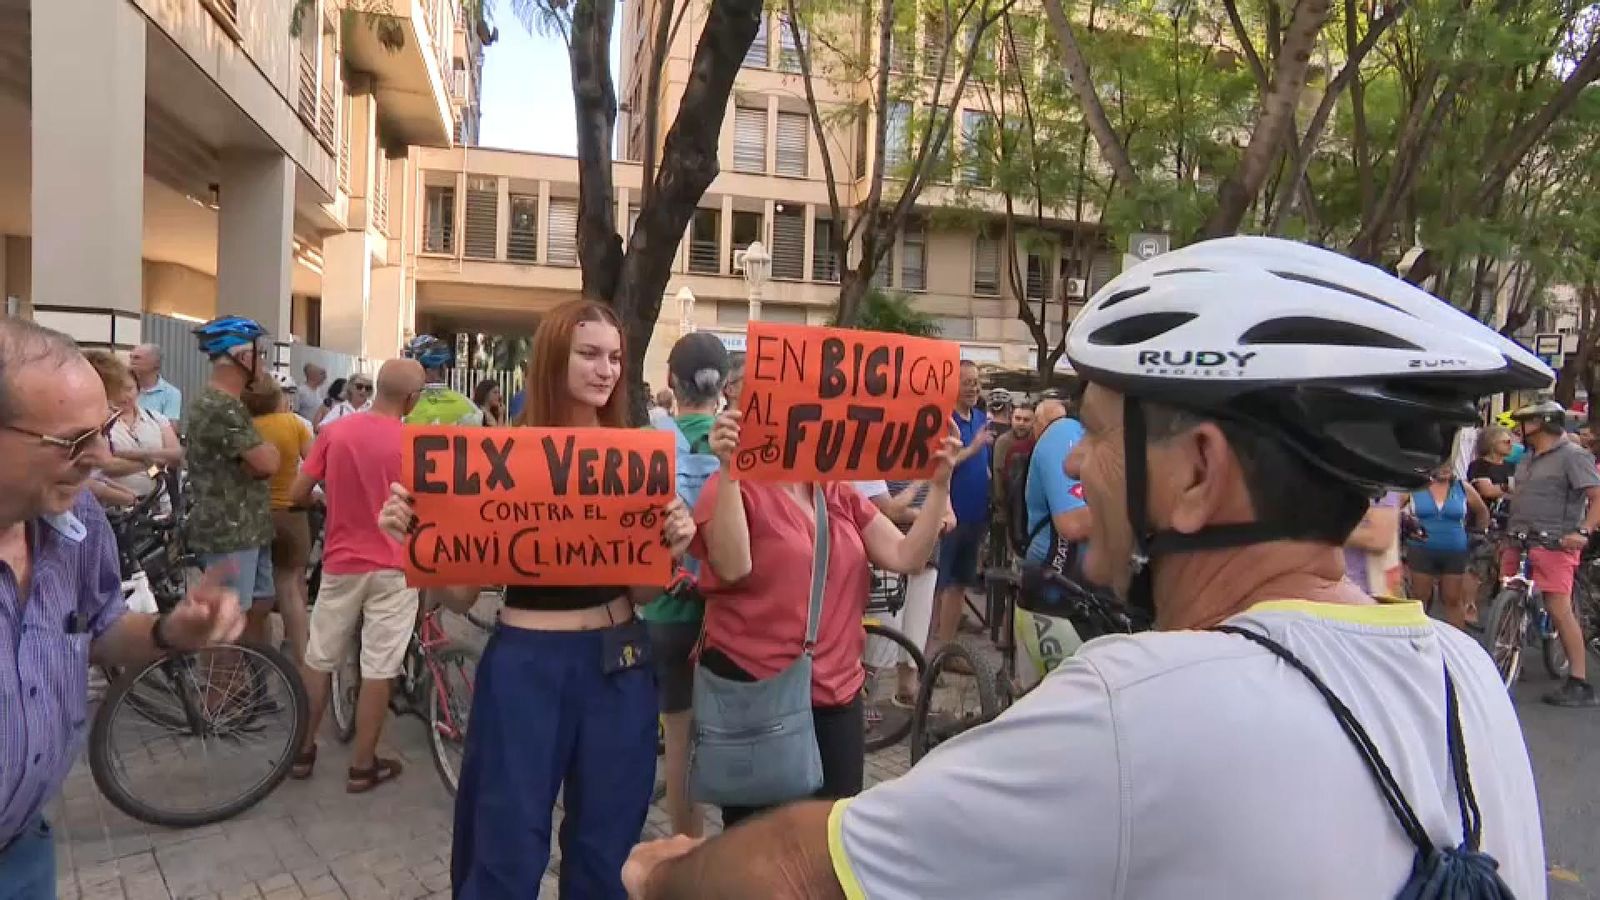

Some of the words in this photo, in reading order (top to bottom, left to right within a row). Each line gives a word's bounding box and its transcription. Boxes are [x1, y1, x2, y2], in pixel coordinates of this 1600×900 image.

[754, 335, 807, 382] EN
[818, 337, 904, 399] BICI
[909, 356, 954, 395] CAP
[1138, 350, 1257, 367] RUDY
[744, 391, 779, 426] AL
[782, 403, 943, 473] FUTUR
[413, 434, 516, 495] ELX
[541, 435, 670, 496] VERDA
[480, 500, 574, 523] CONTRA
[584, 504, 607, 520] EL
